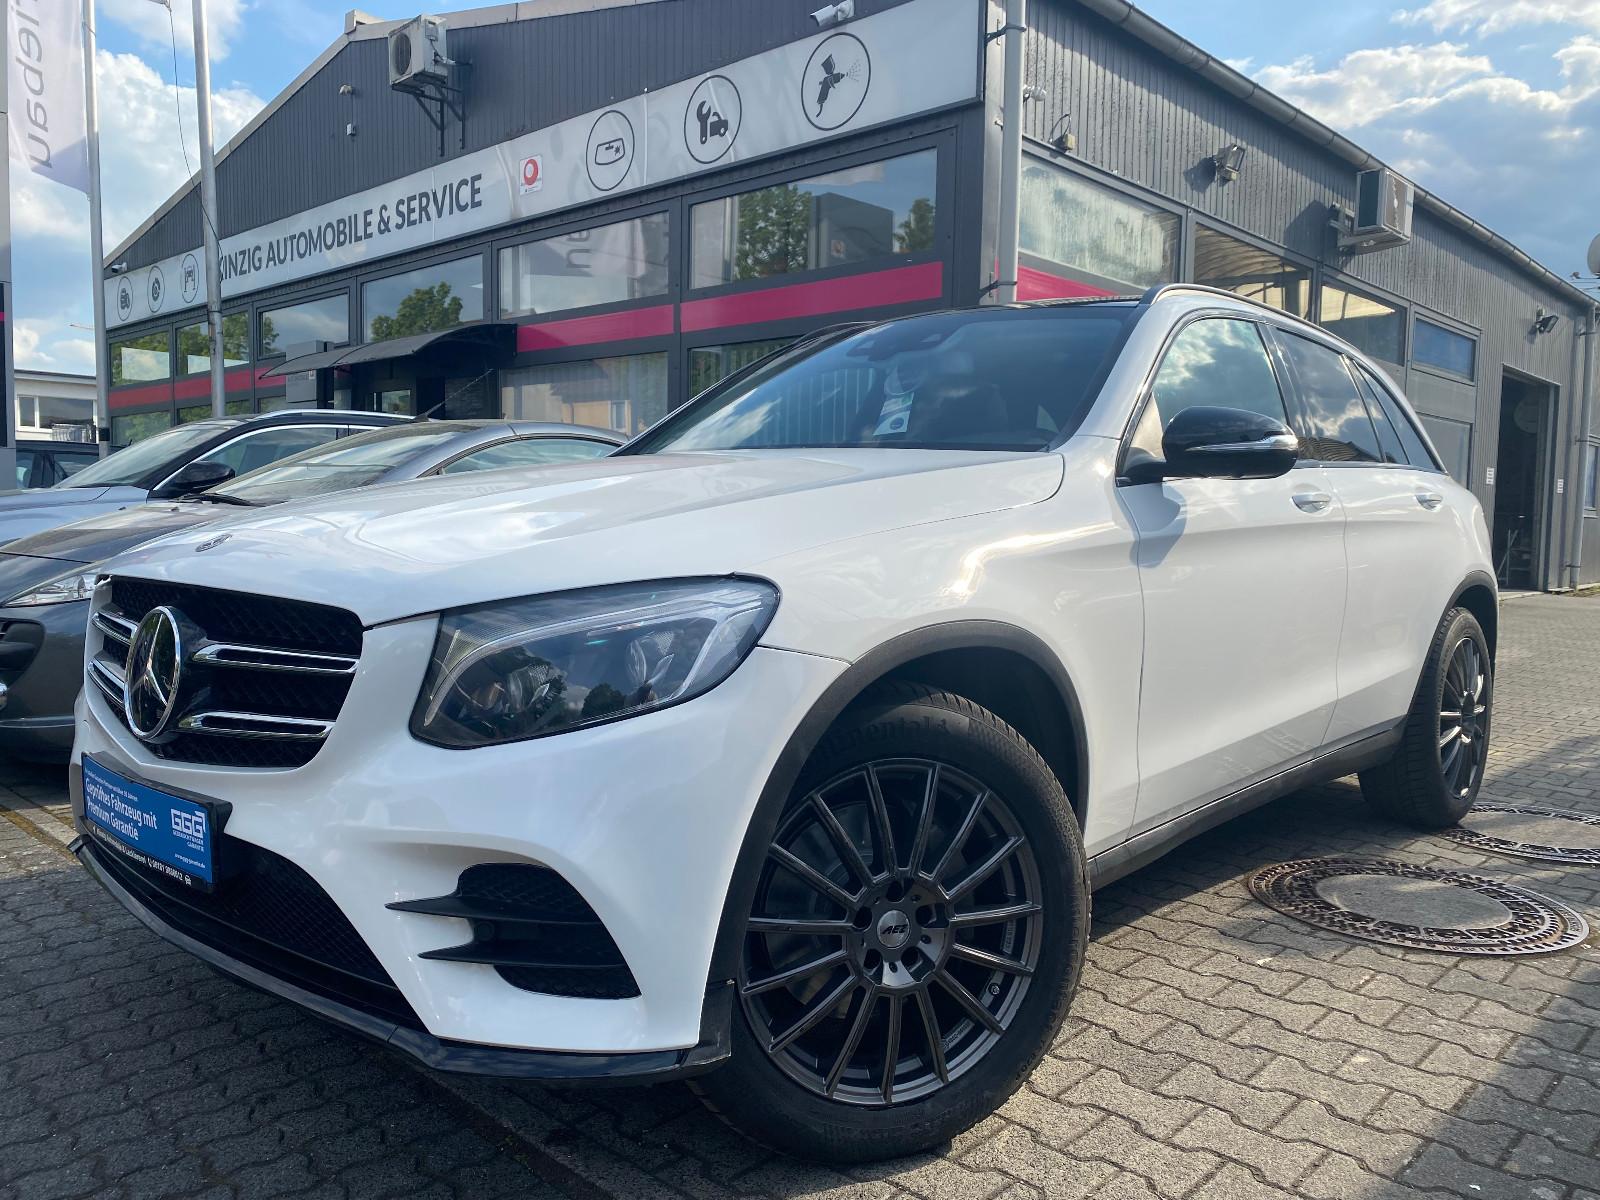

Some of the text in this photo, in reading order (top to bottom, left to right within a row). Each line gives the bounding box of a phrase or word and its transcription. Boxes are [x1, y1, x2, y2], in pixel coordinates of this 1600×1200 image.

[265, 208, 373, 270] AUTOMOBILE
[376, 204, 391, 235] &
[395, 173, 483, 231] SERVICE
[86, 796, 139, 841] Premium Garantie
[111, 794, 142, 827] Fahrzeug
[143, 811, 158, 830] mit
[170, 808, 206, 839] GGG
